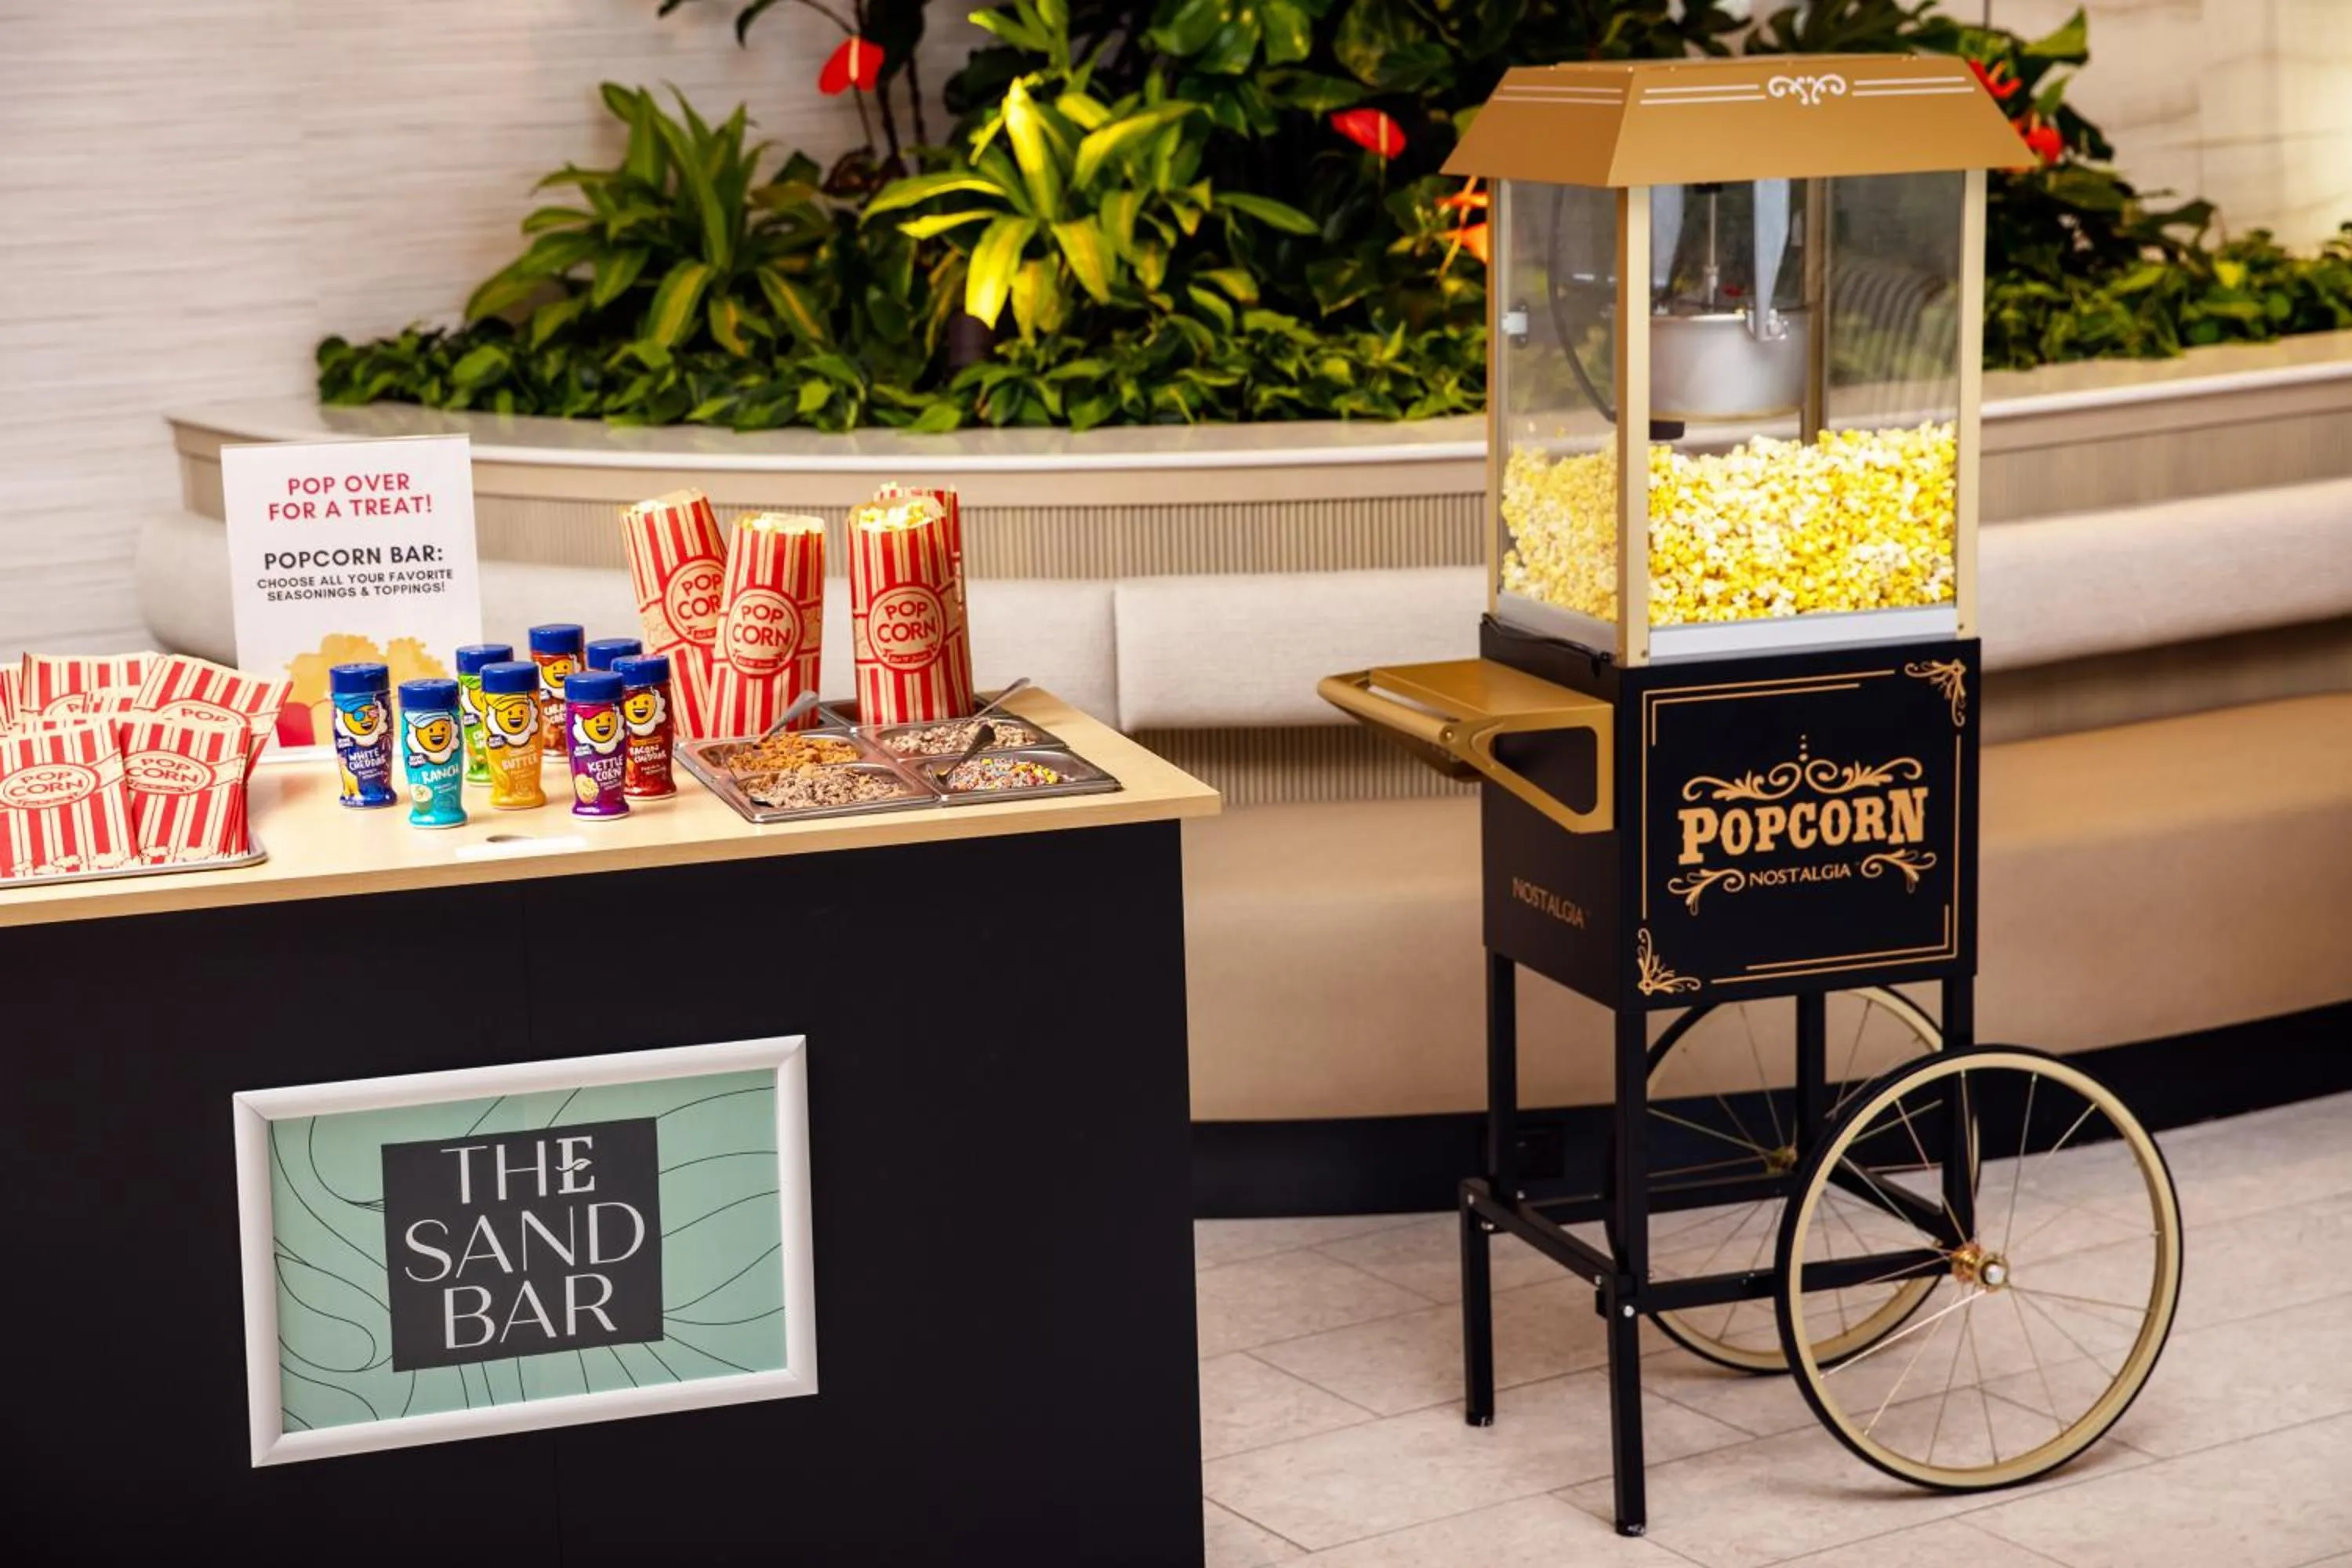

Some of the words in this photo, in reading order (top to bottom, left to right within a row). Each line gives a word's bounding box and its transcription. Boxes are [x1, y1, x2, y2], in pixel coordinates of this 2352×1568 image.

[287, 477, 336, 495] POP
[344, 473, 410, 493] OVER
[268, 502, 315, 521] FOR
[325, 501, 342, 518] A
[349, 494, 432, 517] TREAT!
[263, 548, 382, 571] POPCORN
[391, 545, 444, 564] BAR:
[256, 576, 314, 590] CHOOSE
[320, 575, 343, 586] ALL
[349, 572, 385, 585] YOUR
[389, 569, 453, 583] FAVORITE
[681, 573, 722, 597] POP
[267, 587, 357, 602] SEASONINGS
[361, 586, 370, 597] &
[375, 582, 445, 596] TOPPINGS!
[677, 593, 720, 621] COR
[741, 604, 783, 624] POP
[884, 601, 928, 620] POP
[732, 622, 791, 647] CORN
[877, 616, 937, 643] CORN
[181, 708, 228, 722] POP
[125, 767, 199, 784] CORN
[140, 758, 191, 771] POP
[587, 754, 623, 773] KETTLE
[9, 779, 83, 797] CORN
[20, 771, 72, 784] POP
[1678, 786, 1929, 865] POPCORN
[1749, 862, 1852, 887] NOSTALGIA
[1512, 877, 1585, 930] NOSTALGIA
[441, 1135, 596, 1204] THE
[404, 1202, 646, 1283] SAND
[442, 1273, 618, 1351] BAR
